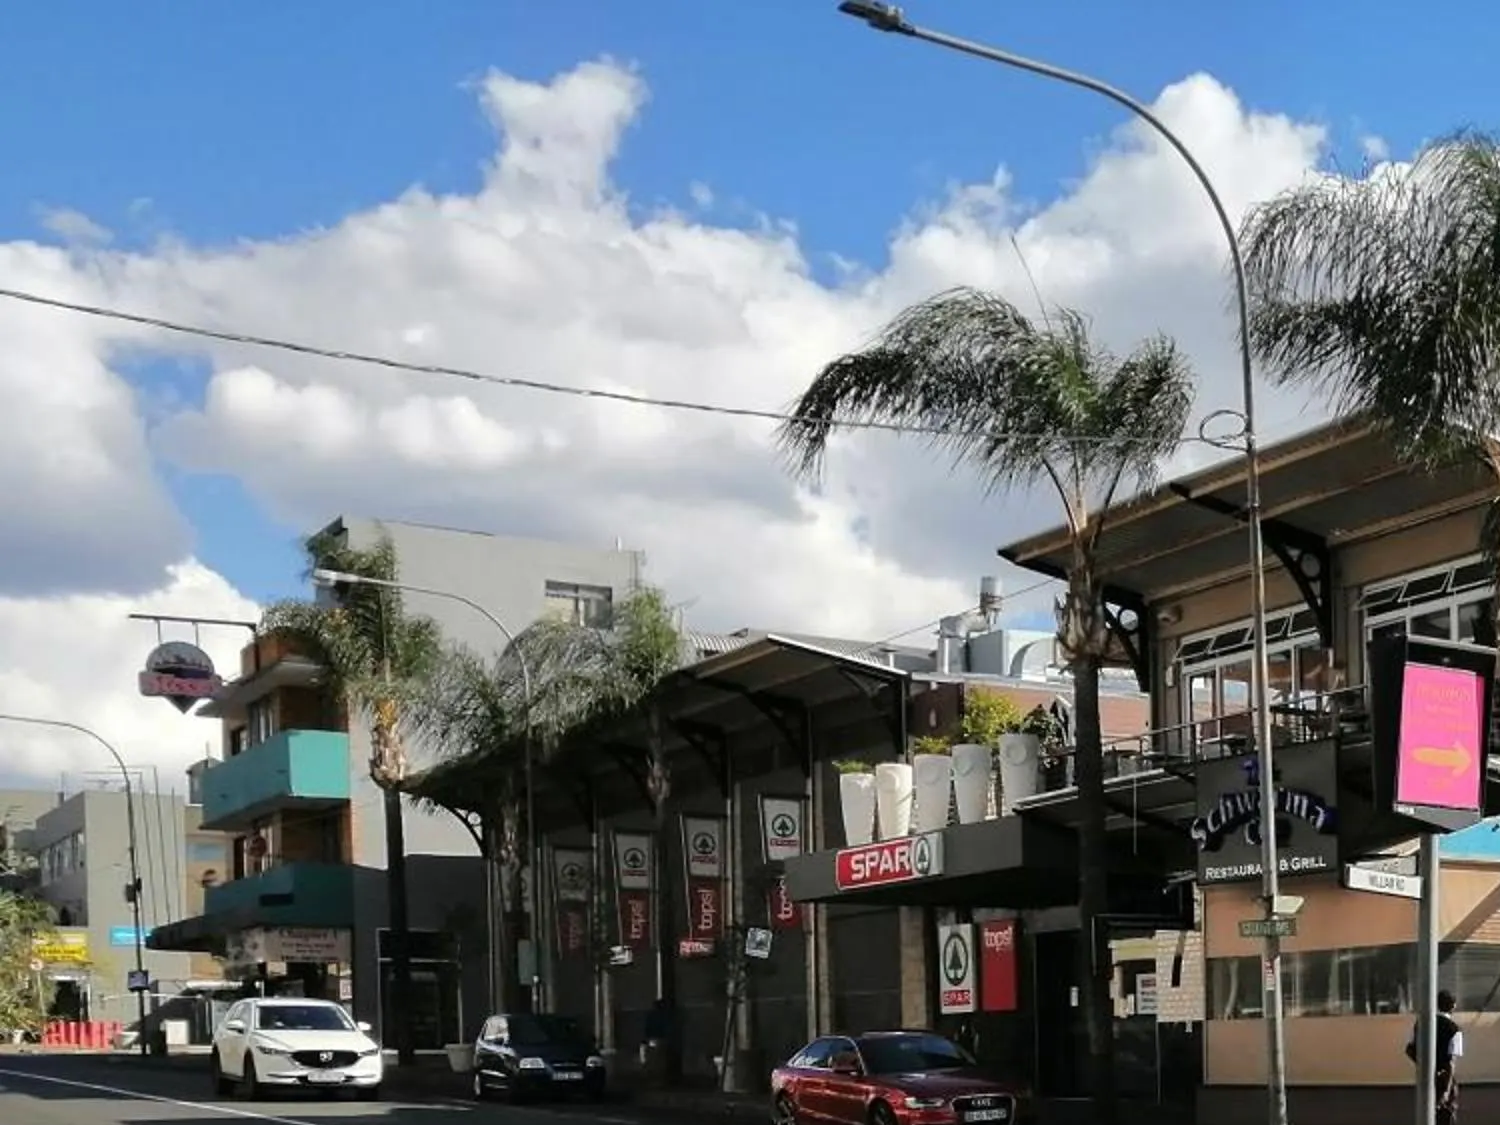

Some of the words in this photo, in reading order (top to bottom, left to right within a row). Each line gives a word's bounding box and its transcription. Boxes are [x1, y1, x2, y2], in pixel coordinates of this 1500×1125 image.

[850, 845, 911, 881] SPAR
[1205, 863, 1263, 880] RESTAURA
[1279, 858, 1289, 871] &
[1290, 855, 1327, 871] GRILL
